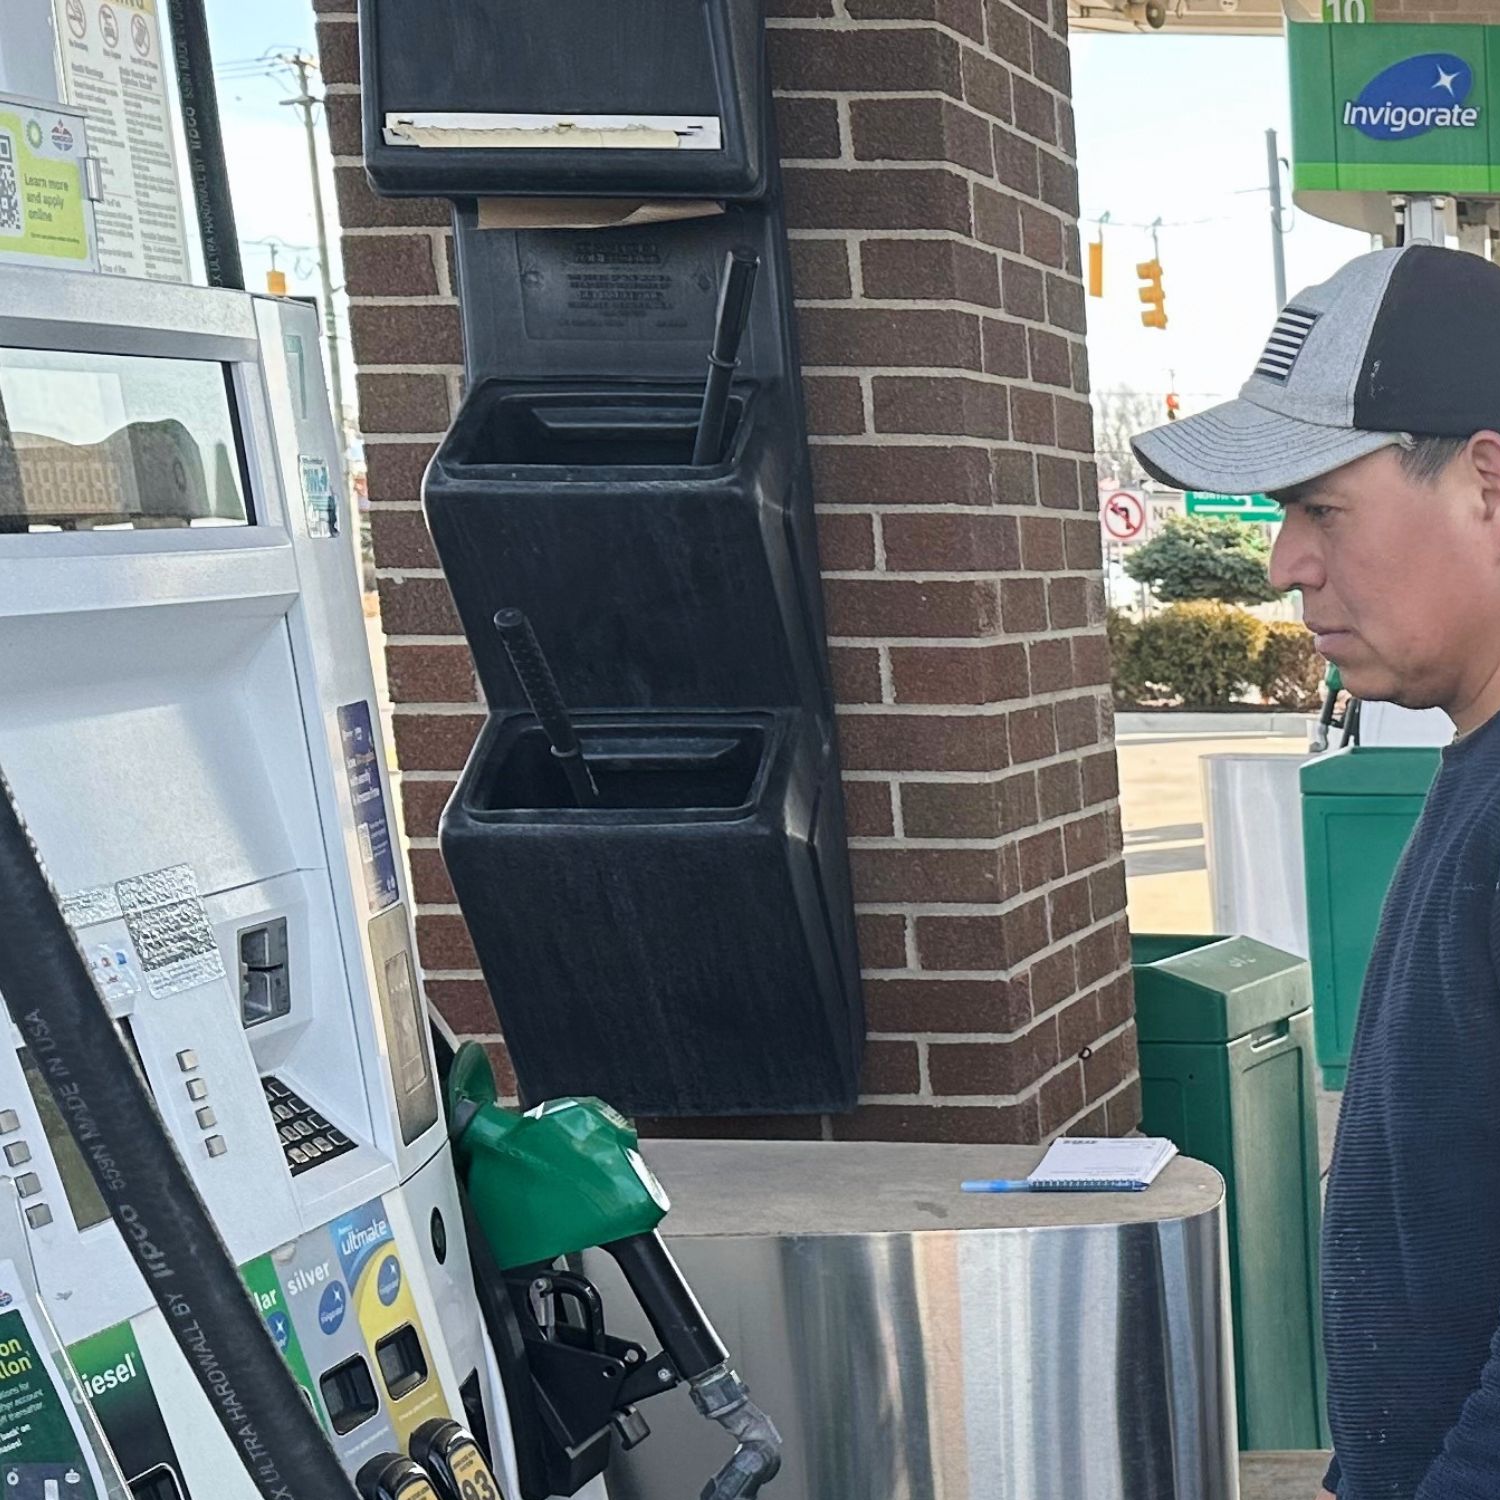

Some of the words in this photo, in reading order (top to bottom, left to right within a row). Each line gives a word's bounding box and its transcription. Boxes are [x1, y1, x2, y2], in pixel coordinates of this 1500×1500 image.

[1343, 101, 1478, 132] Invigorate
[24, 172, 47, 188] Learn
[48, 179, 69, 191] more
[26, 191, 42, 204] and
[28, 208, 53, 222] online
[23, 1008, 52, 1054] USA
[57, 1080, 101, 1140] MADE
[341, 1217, 389, 1256] ultimate
[286, 1261, 331, 1297] silver
[171, 1290, 194, 1318] BY
[185, 1316, 248, 1418] HARDWALL
[235, 1416, 282, 1485] ULTRA
